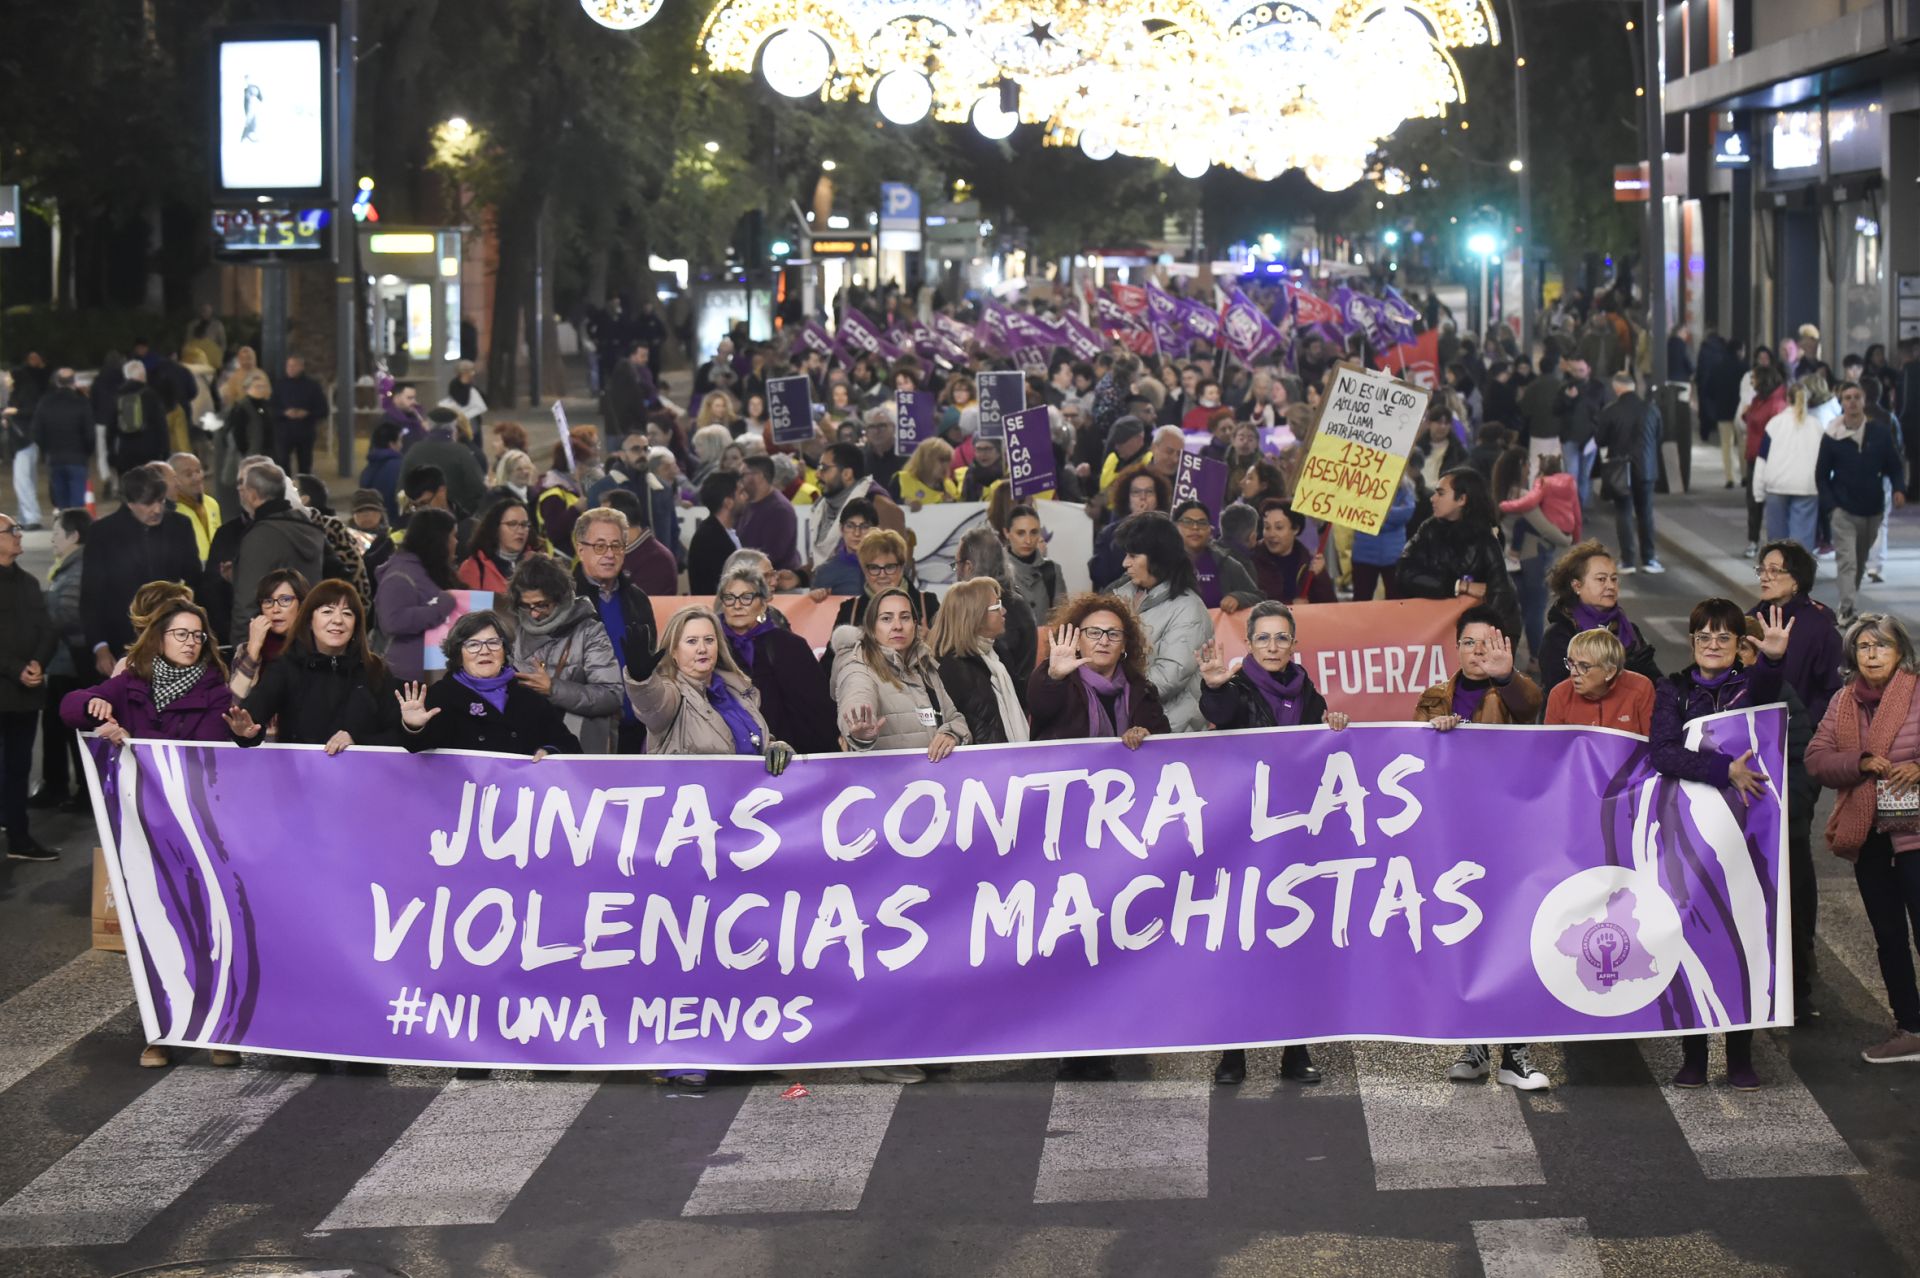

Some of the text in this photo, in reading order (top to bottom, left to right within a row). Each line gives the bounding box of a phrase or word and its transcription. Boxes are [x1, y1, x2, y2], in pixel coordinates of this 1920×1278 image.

[889, 187, 912, 215] P
[770, 382, 785, 393] SE
[980, 376, 997, 386] SE
[772, 395, 781, 404] A
[899, 393, 914, 404] SE
[981, 388, 990, 398] A
[1338, 377, 1416, 409] NO ES UN CASO
[773, 406, 790, 416] CA
[900, 405, 908, 415] A
[981, 399, 1000, 409] CA
[1378, 404, 1395, 417] SE
[900, 417, 916, 427] CA
[1006, 416, 1024, 431] SE
[1347, 412, 1373, 430] LLAMA
[1010, 434, 1020, 447] A
[1325, 421, 1392, 450] PATRIARCADO
[1011, 447, 1031, 462] CA
[1183, 454, 1202, 471] SE
[1338, 442, 1388, 474] 1334
[1013, 459, 1032, 479] BÓ
[1181, 469, 1191, 483] A
[1303, 455, 1391, 501] ASESINADAS
[1178, 484, 1198, 501] CA
[1297, 487, 1313, 510] Y
[1312, 492, 1335, 515] 65
[1317, 645, 1449, 695] FUERZA
[428, 752, 1427, 882] JUNTAS CONTRA LAS
[370, 883, 932, 982] VIOLENCIAS
[969, 855, 1487, 968] MACHISTAS
[386, 986, 815, 1049] #NI UNA MENOS
